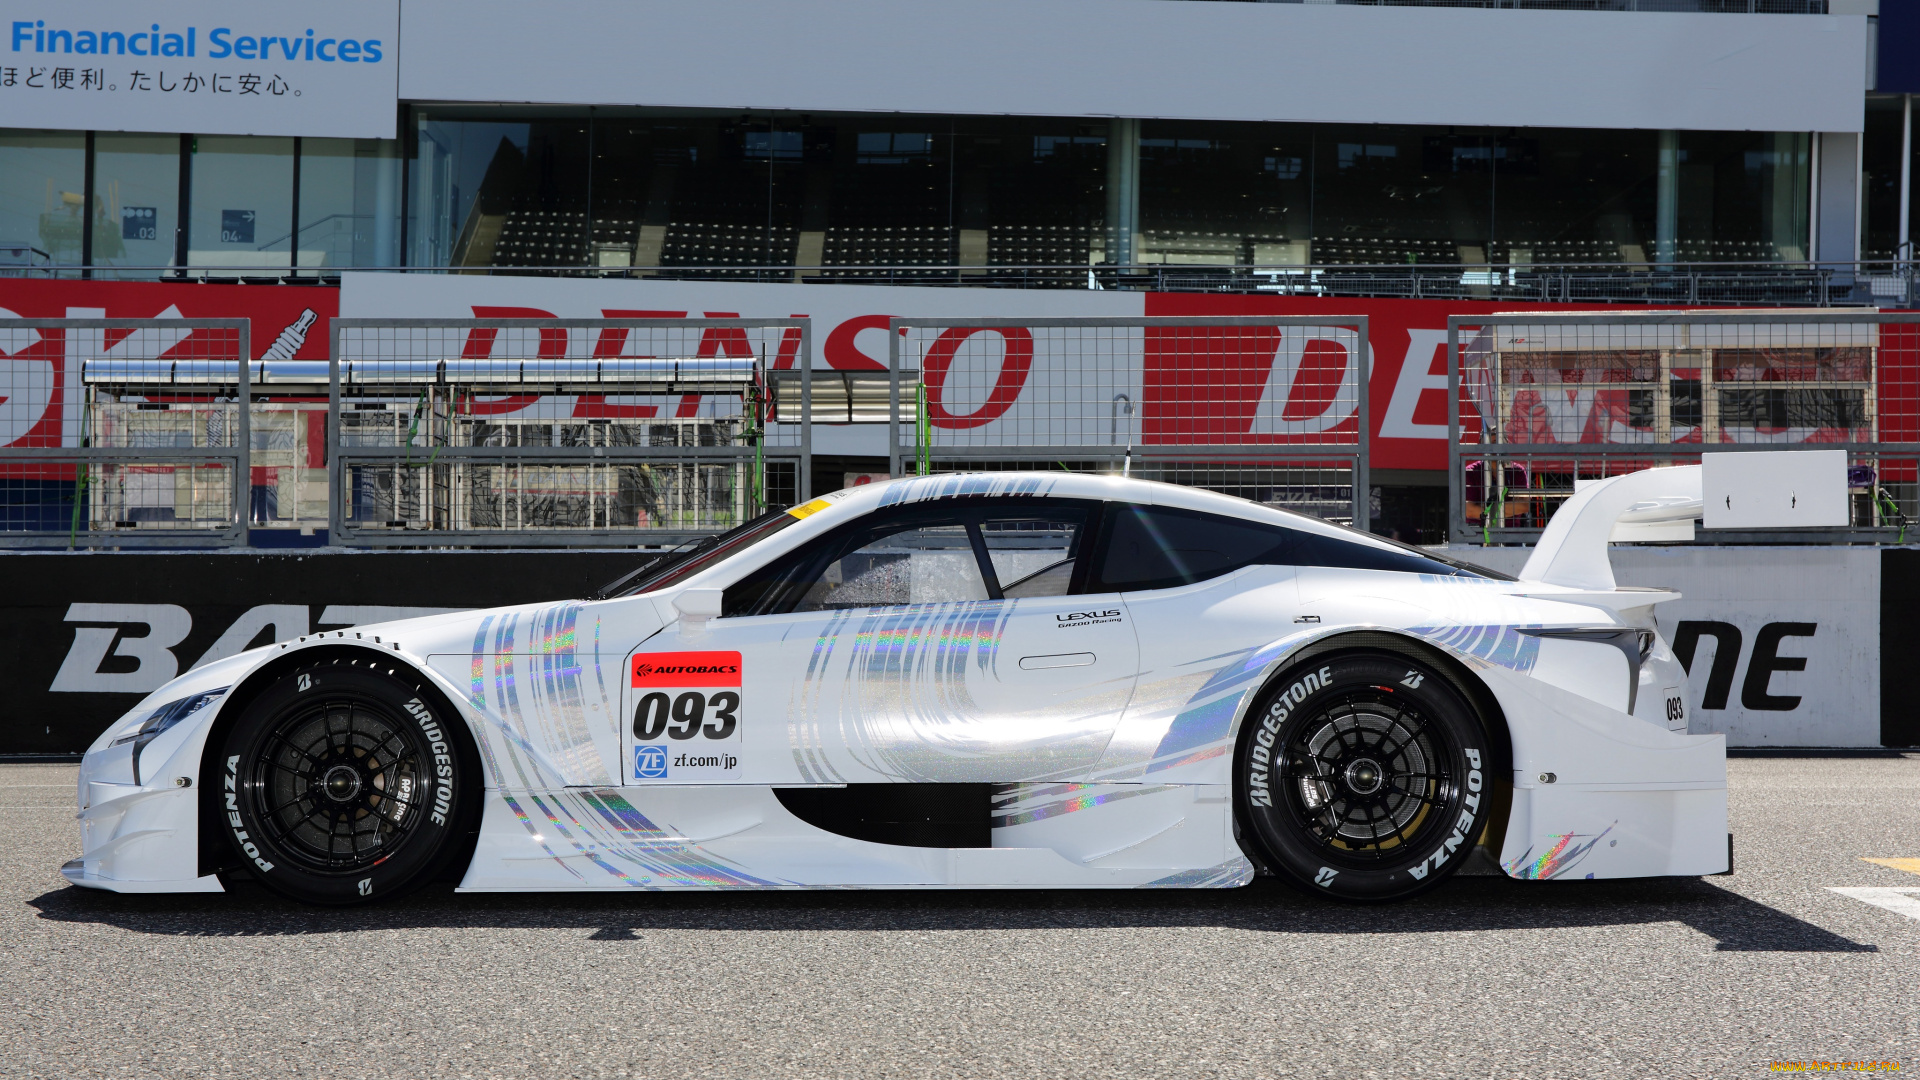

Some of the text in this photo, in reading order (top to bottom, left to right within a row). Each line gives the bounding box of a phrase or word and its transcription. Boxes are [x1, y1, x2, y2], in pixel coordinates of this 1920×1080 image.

[11, 20, 383, 63] Financial Services
[138, 227, 155, 240] 03
[222, 230, 238, 242] 04
[1056, 609, 1121, 621] LEXUS
[633, 691, 740, 740] 093
[1666, 697, 1684, 721] 093
[1250, 666, 1333, 808] BRIDGESTONE
[403, 698, 453, 827] BRIDGESTONE
[674, 753, 737, 769] zf.com/jp
[224, 754, 275, 873] POTENZA
[1407, 748, 1483, 881] POTENZA
